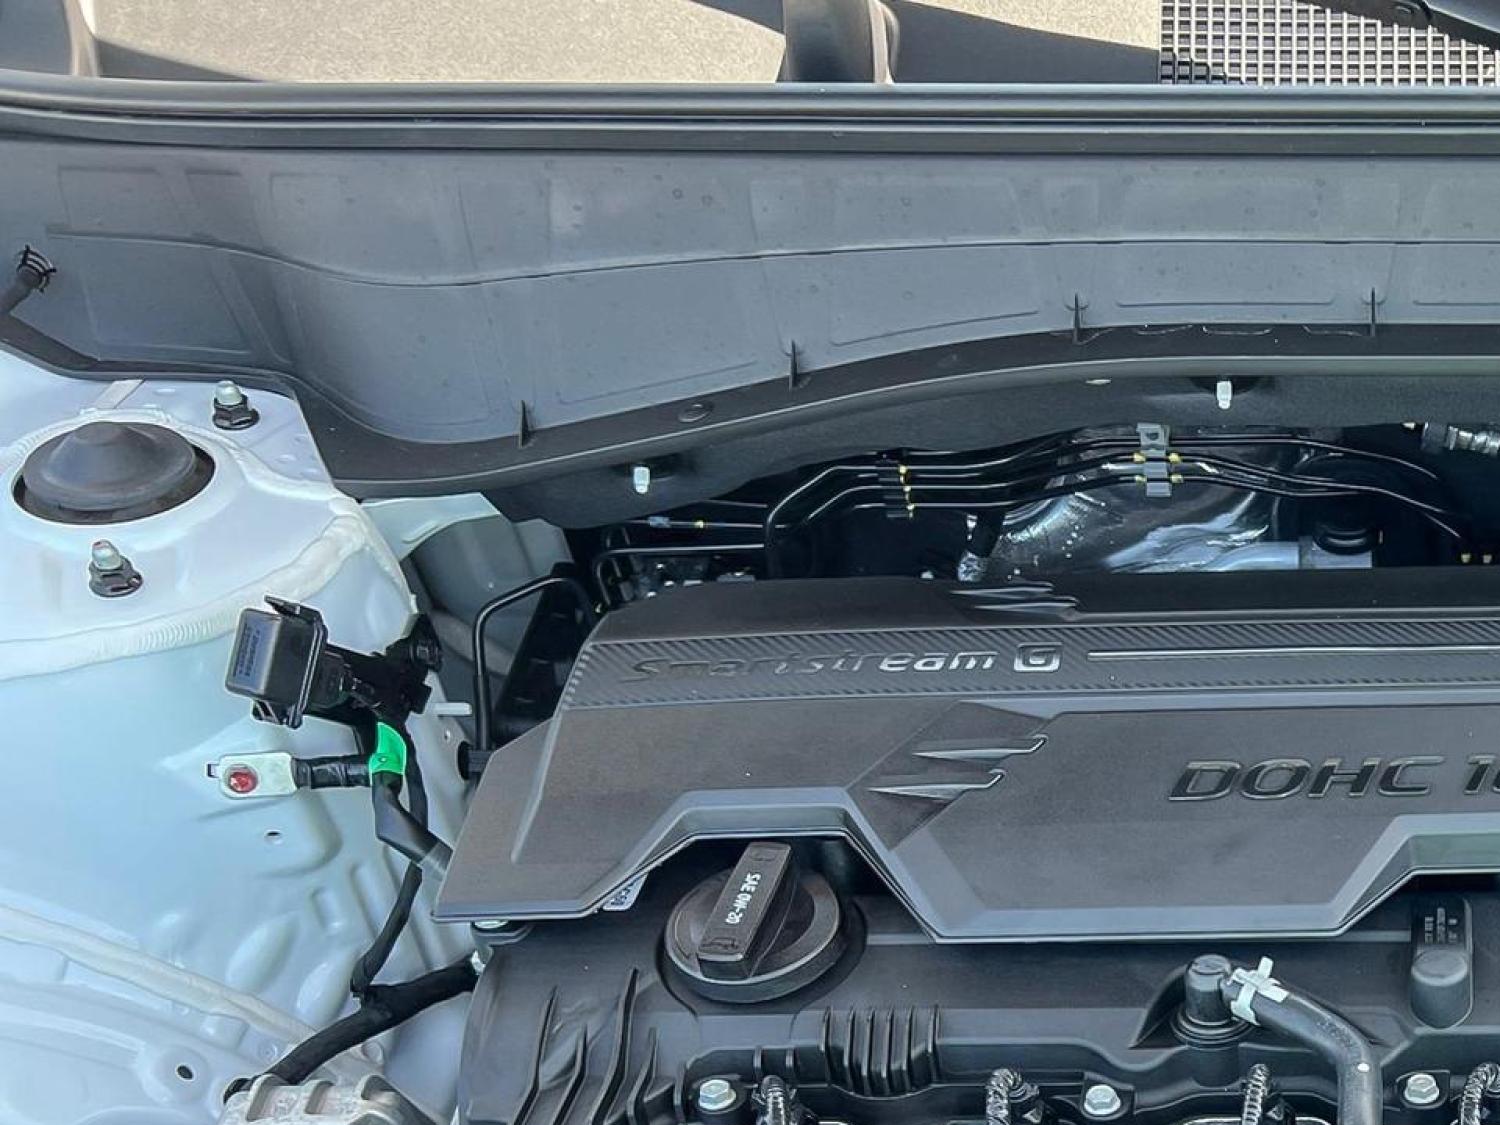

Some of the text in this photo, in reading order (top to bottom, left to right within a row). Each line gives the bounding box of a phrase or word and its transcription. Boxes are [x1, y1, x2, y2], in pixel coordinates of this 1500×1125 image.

[620, 648, 1000, 683] Smartstream
[1168, 755, 1444, 801] DOHC
[725, 871, 761, 925] SAE 0W-20
